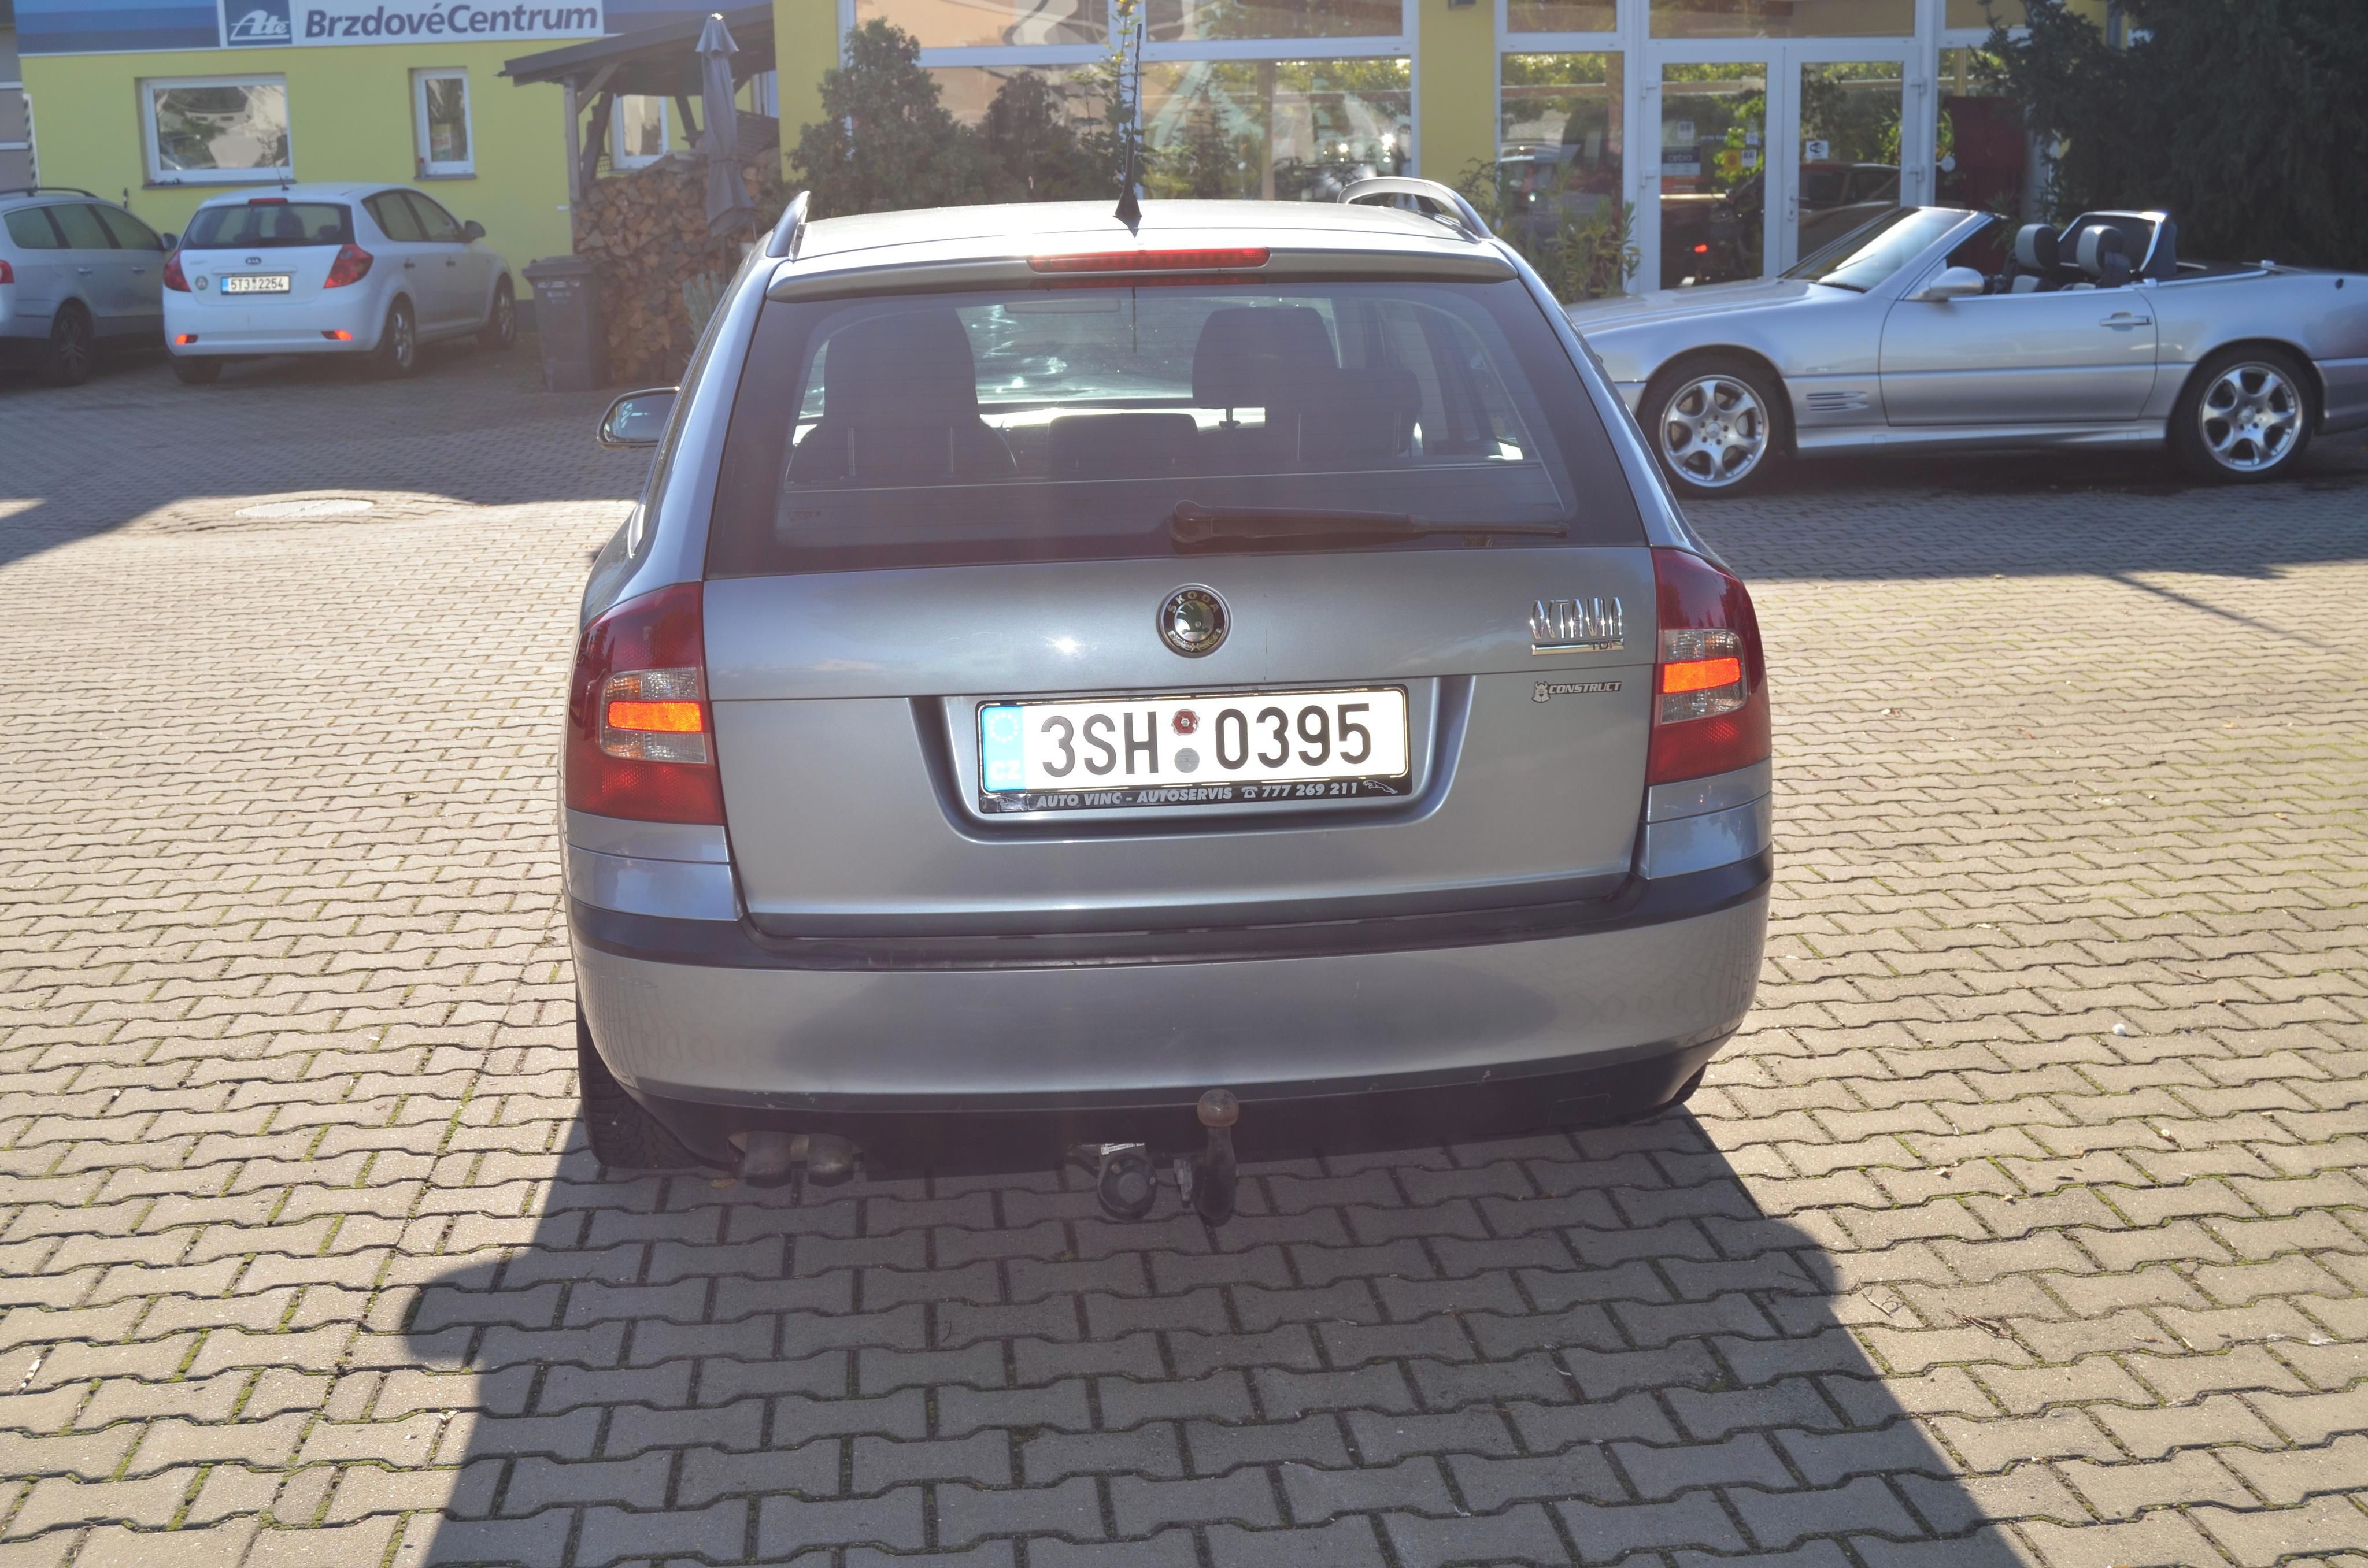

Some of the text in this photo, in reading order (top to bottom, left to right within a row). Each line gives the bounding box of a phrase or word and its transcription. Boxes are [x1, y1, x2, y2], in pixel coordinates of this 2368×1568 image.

[305, 2, 597, 38] BrzdovéCentrum
[231, 277, 283, 290] 5T3 2254
[1549, 682, 1622, 694] CONSTRUCT
[1041, 703, 1371, 777] 3SH 0395
[990, 760, 1022, 781] CZ
[1035, 794, 1079, 809] AUTO
[1136, 787, 1232, 803] AUTOSERVIS
[1261, 785, 1292, 798] 777
[1295, 783, 1325, 796] 269
[1330, 782, 1357, 795] 211
